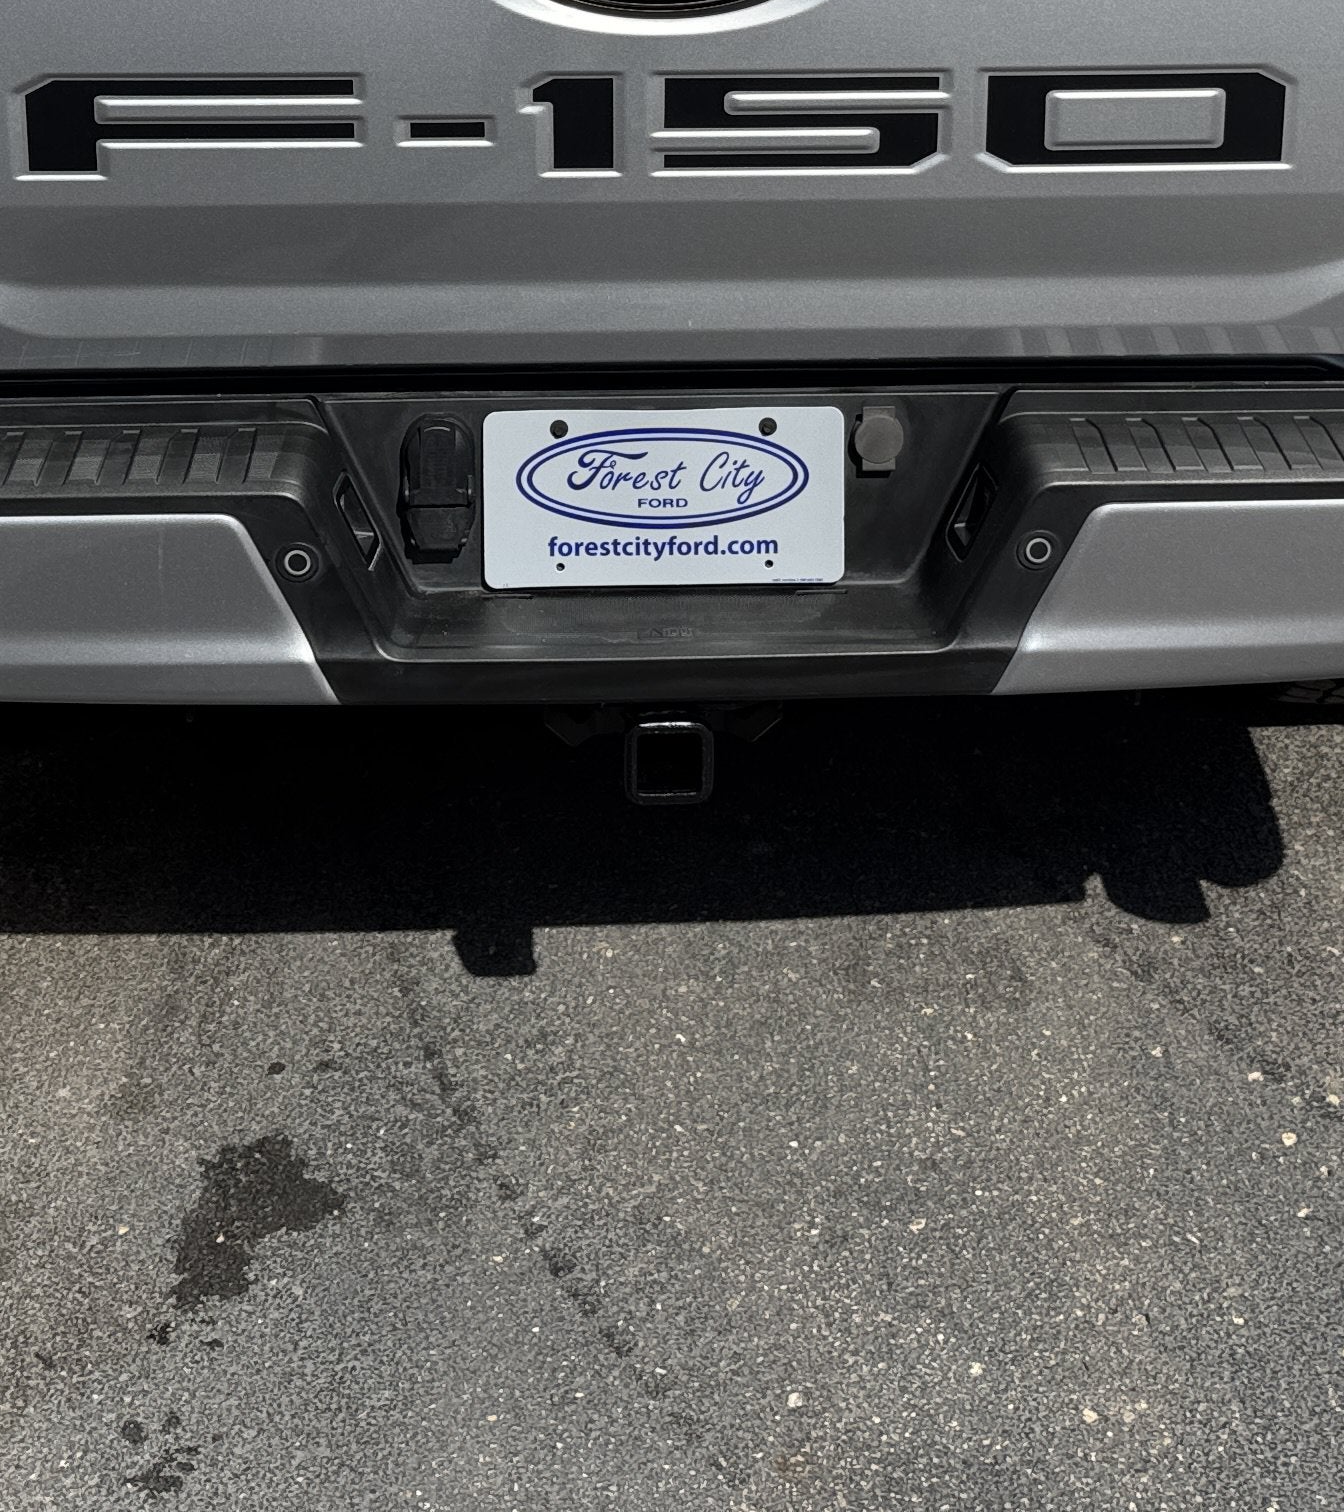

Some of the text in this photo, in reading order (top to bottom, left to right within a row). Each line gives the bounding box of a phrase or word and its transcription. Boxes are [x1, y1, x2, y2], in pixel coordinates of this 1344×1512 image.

[18, 68, 1292, 180] F-150
[567, 449, 766, 505] Forest City
[637, 497, 689, 509] FORD
[548, 534, 778, 561] forestcityford.com
